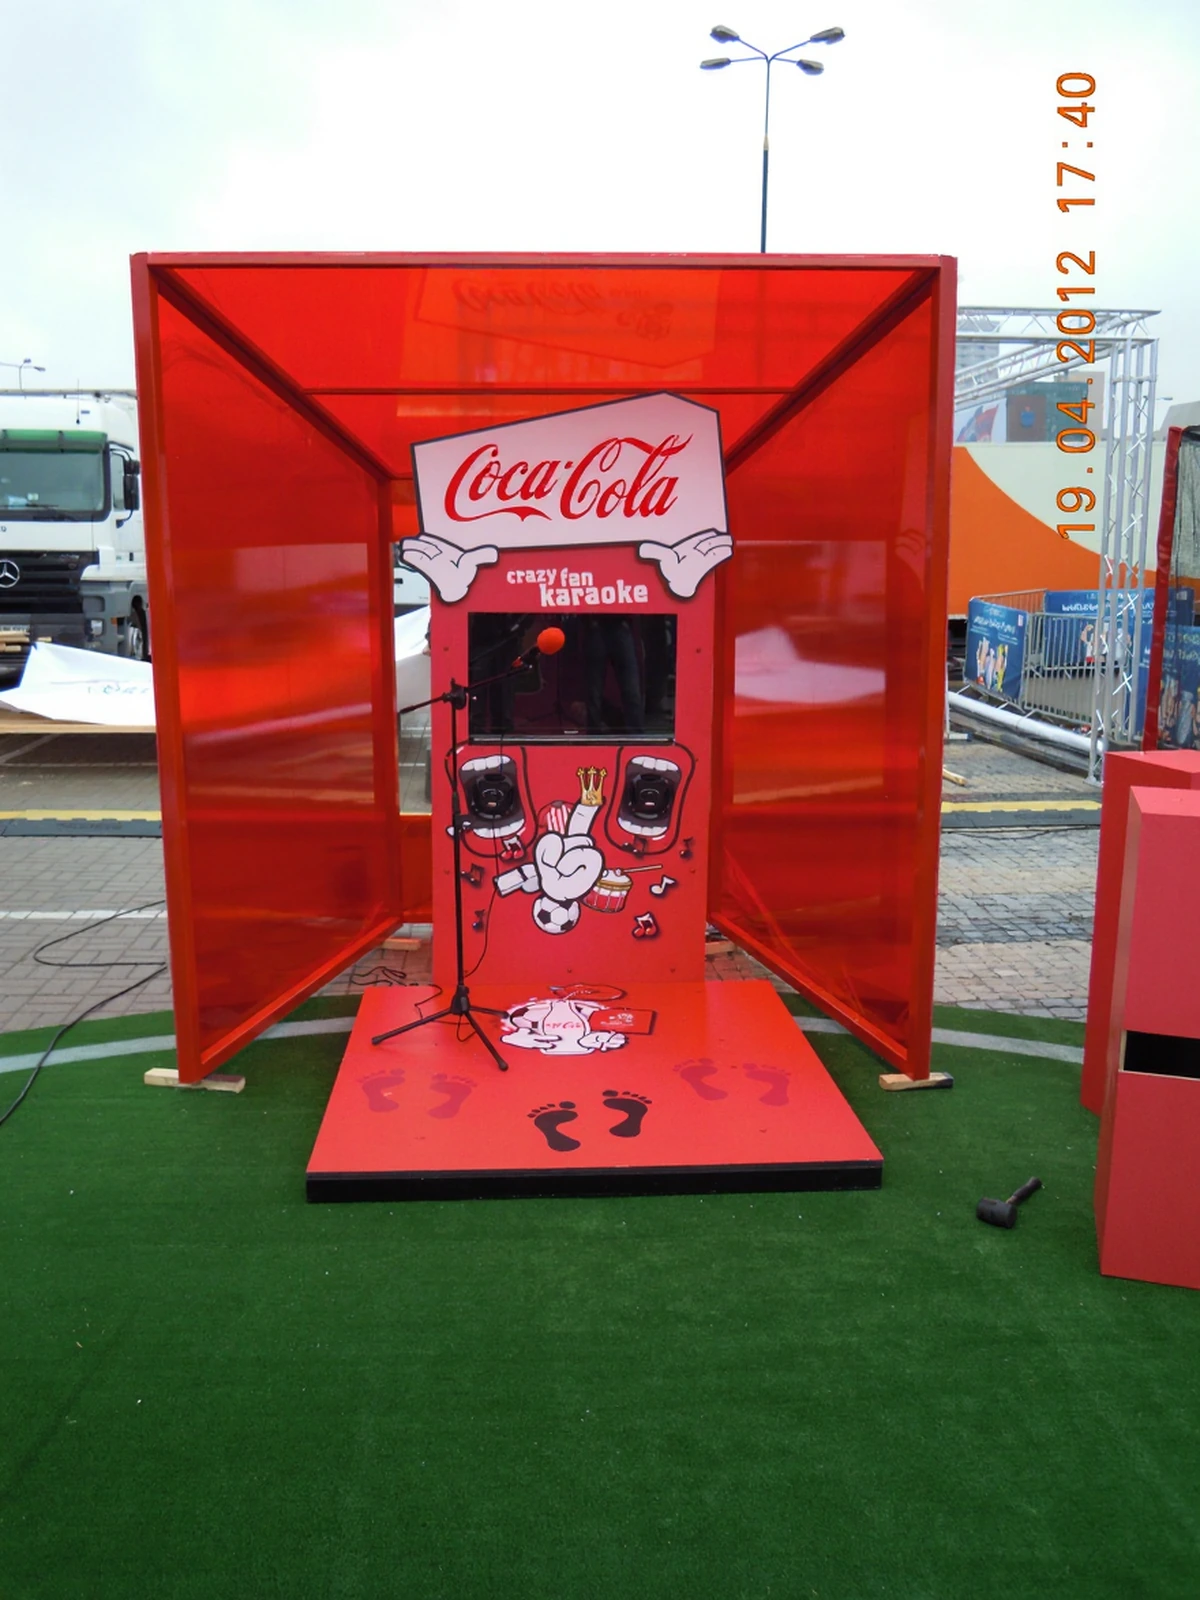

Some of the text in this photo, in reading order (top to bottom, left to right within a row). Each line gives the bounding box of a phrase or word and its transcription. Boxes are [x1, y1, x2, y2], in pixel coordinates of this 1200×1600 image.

[444, 434, 693, 522] Coca-Cola
[506, 567, 594, 587] crazy fan
[539, 579, 649, 607] karaoke
